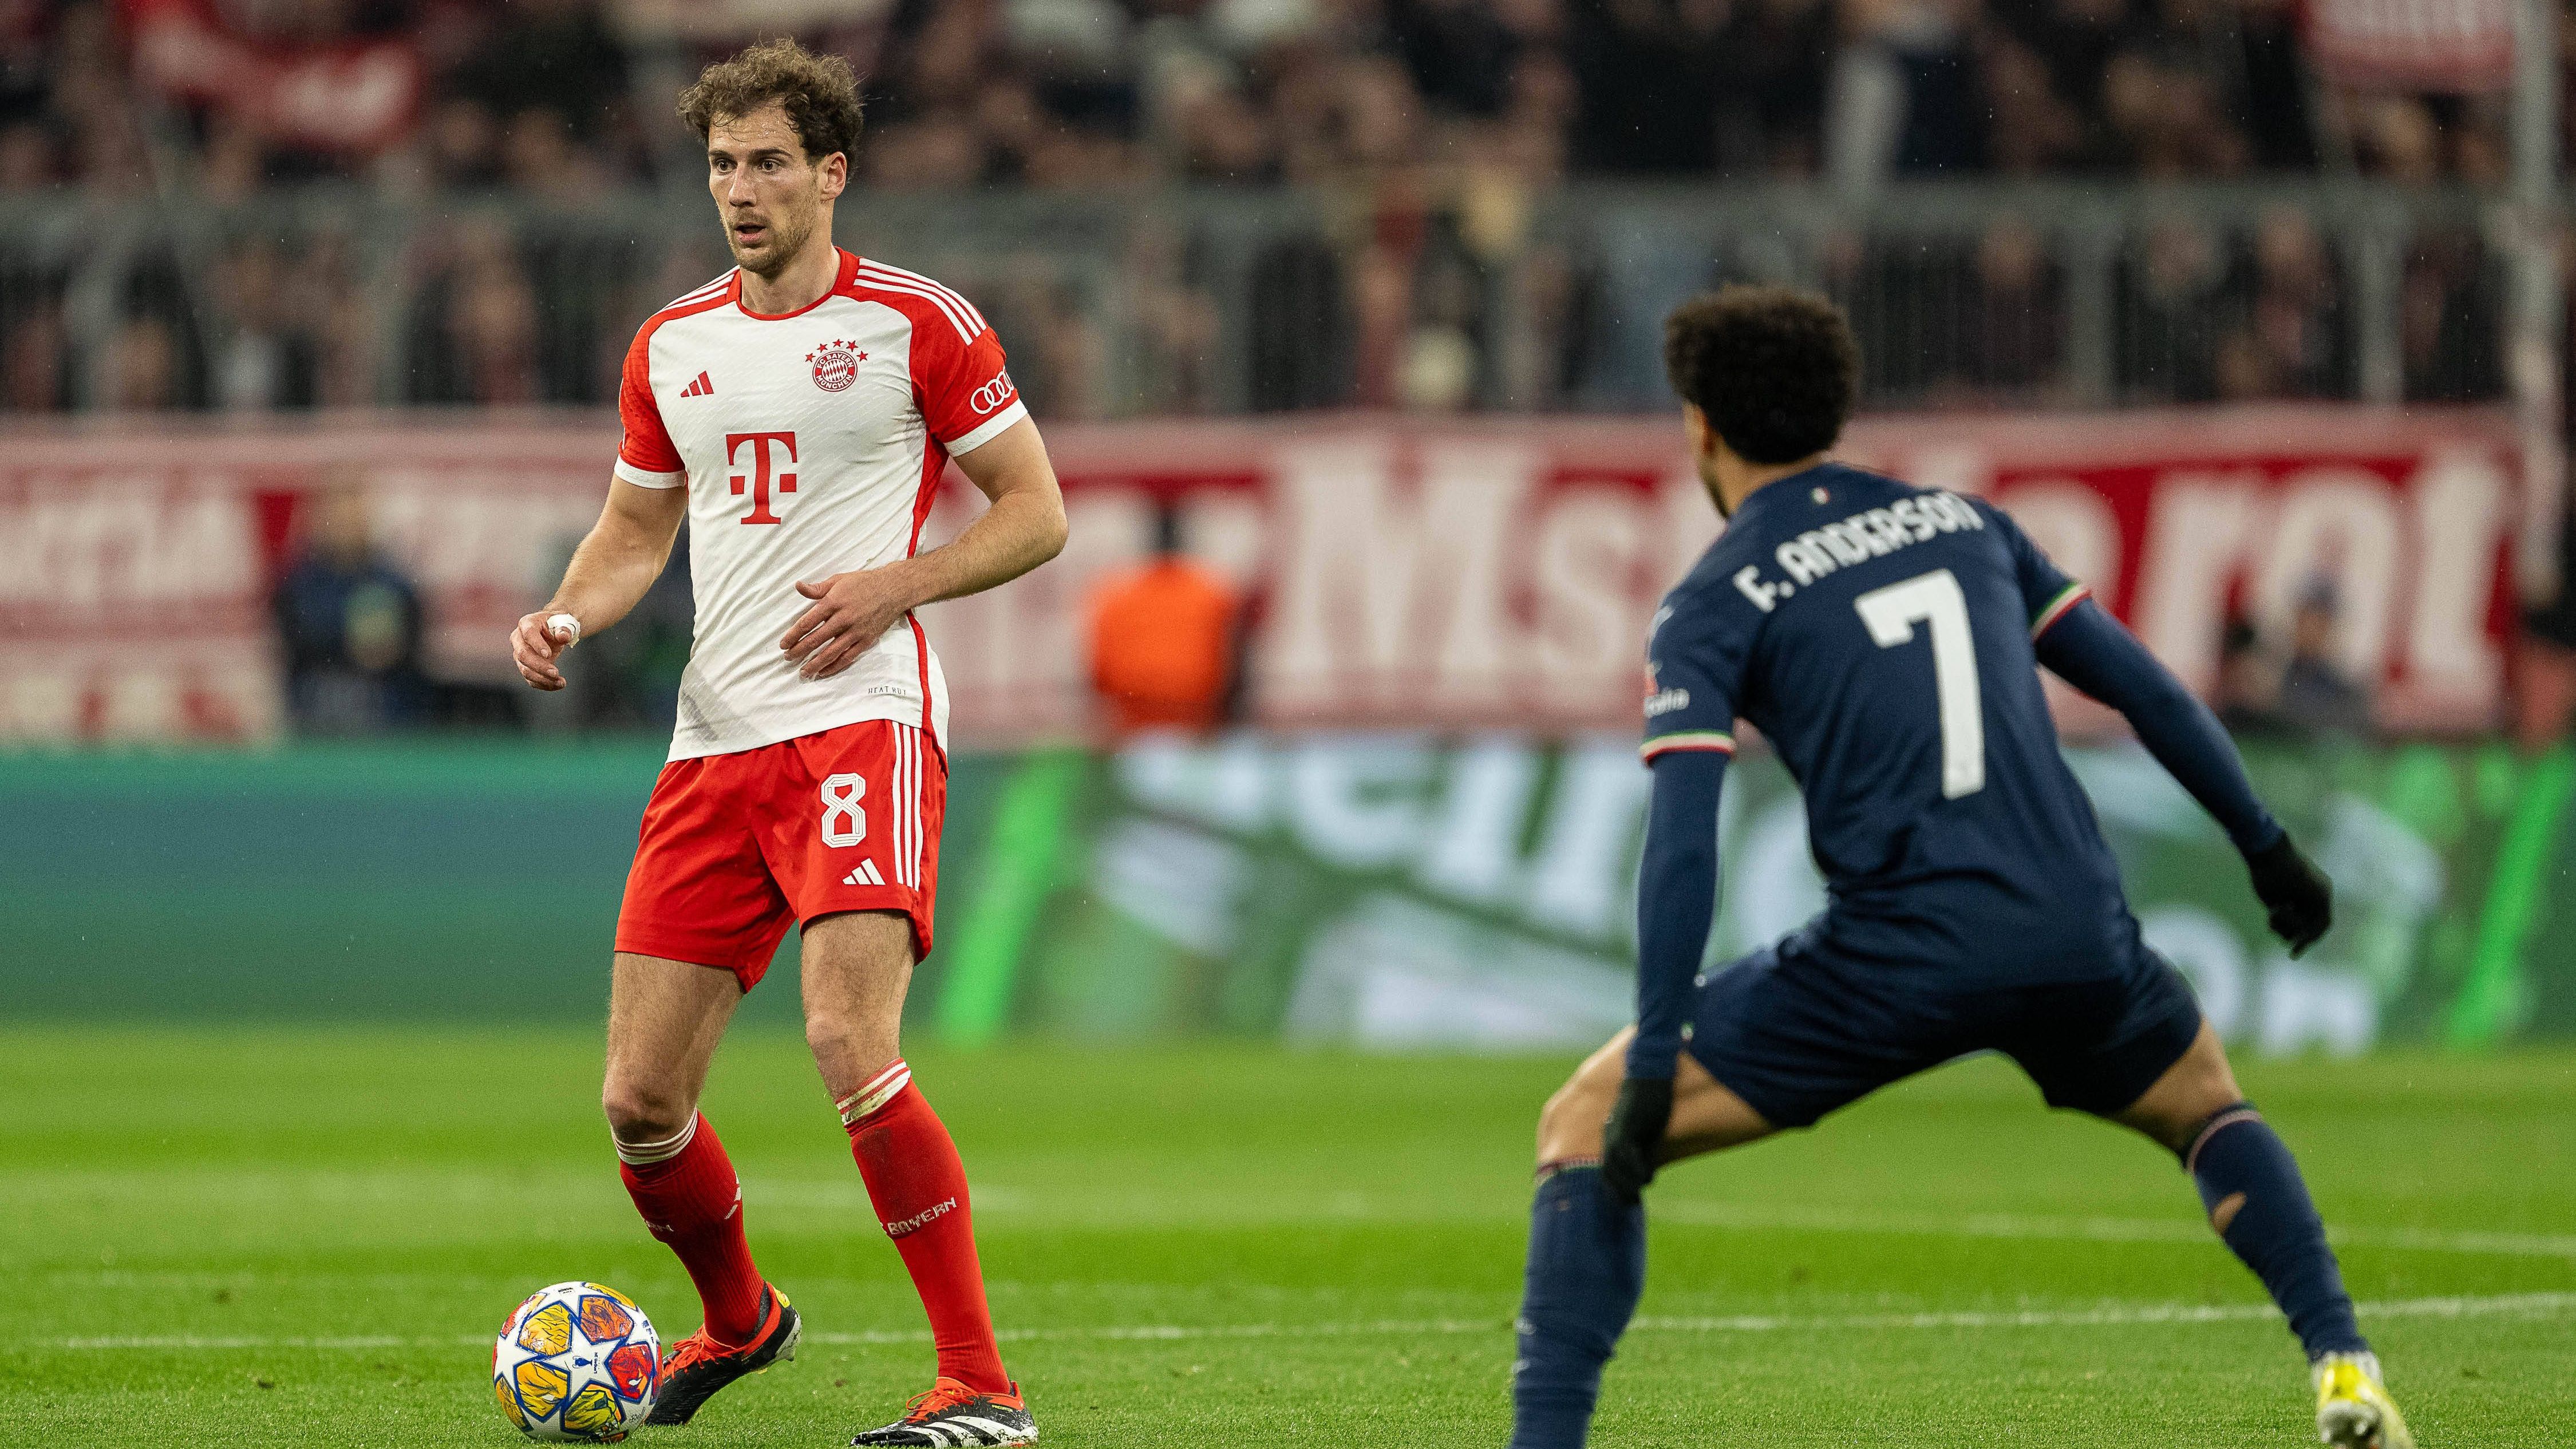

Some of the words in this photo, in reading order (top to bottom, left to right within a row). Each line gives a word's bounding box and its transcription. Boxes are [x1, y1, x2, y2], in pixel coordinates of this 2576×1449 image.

[817, 358, 826, 368] FC
[826, 353, 854, 368] BAYERN
[726, 432, 797, 524] T
[1732, 564, 1796, 613] F.
[1776, 491, 1985, 586] ANDERSON
[1854, 568, 1985, 800] 7
[821, 772, 867, 848] 8
[887, 1197, 957, 1235] BAYERN
